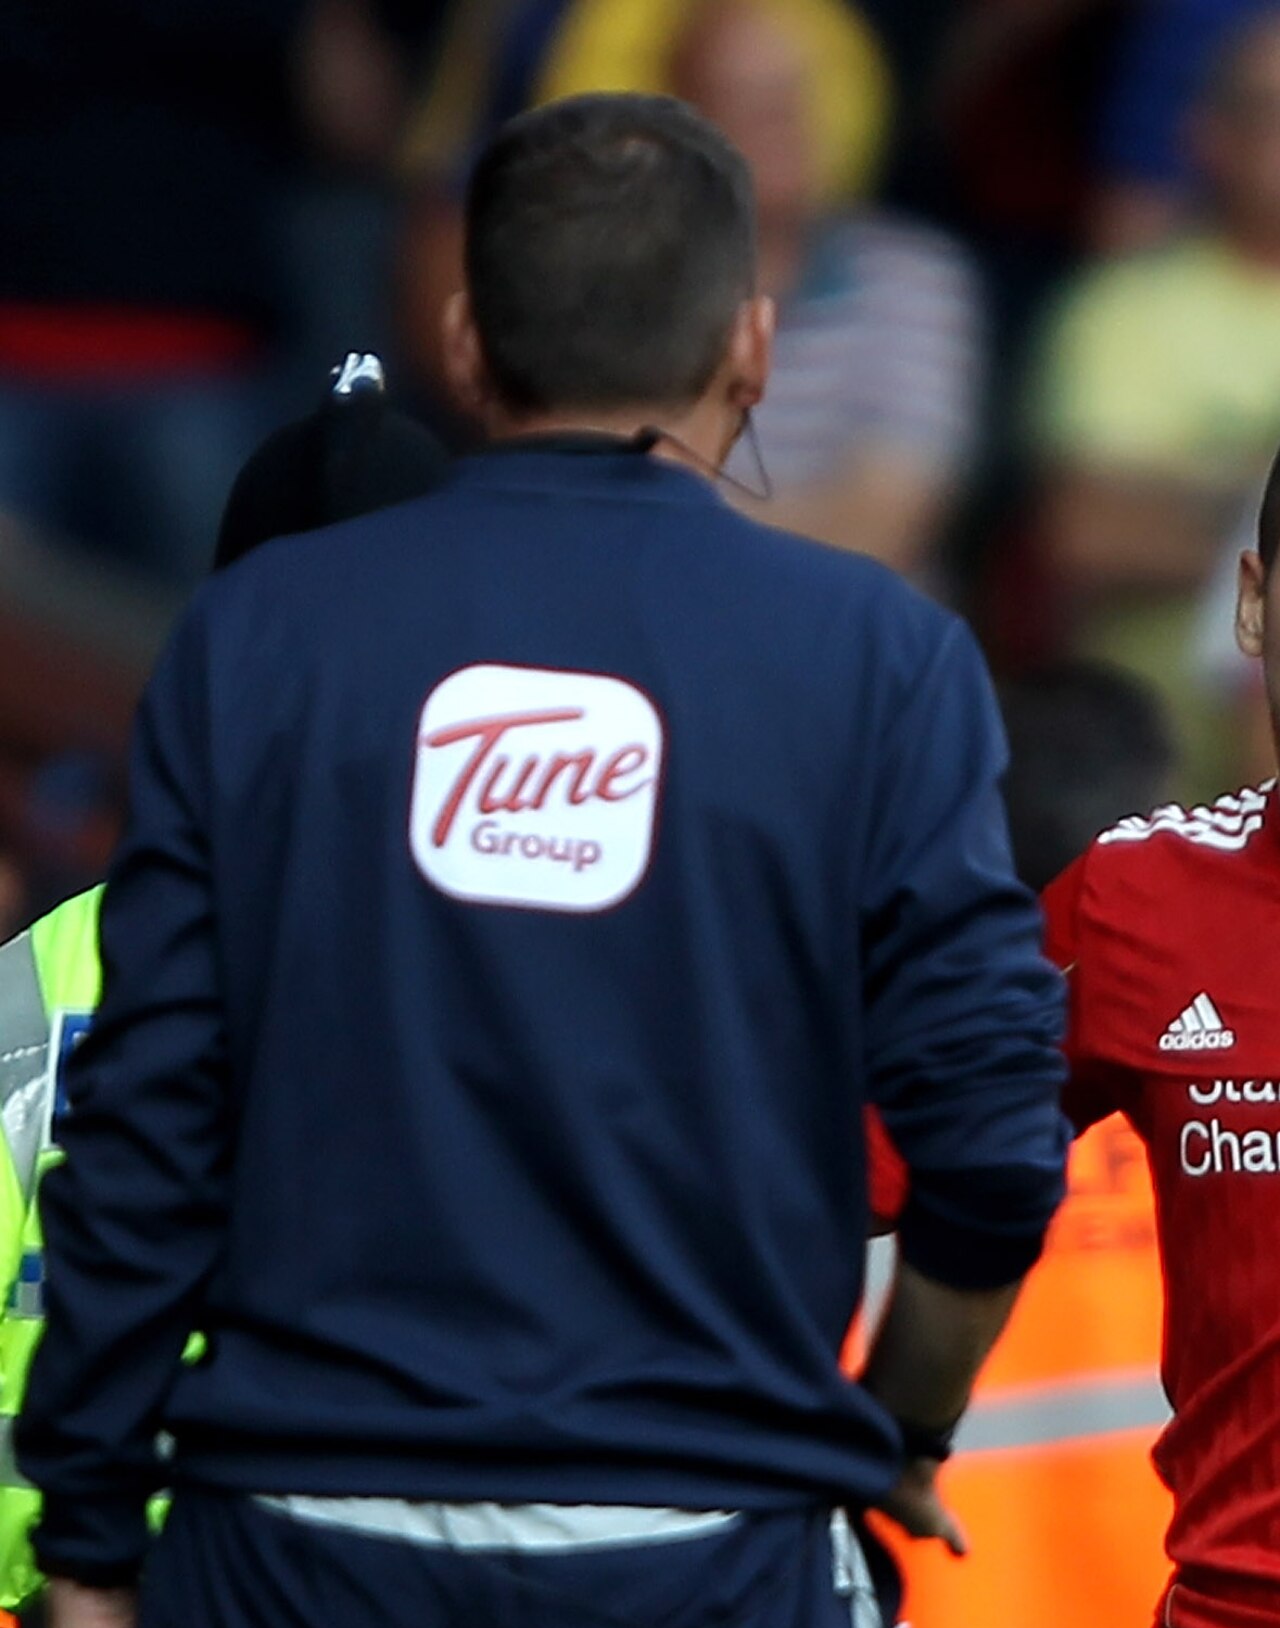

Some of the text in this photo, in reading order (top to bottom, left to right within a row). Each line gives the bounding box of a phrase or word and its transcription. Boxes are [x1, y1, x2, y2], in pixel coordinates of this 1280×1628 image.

[425, 706, 653, 849] Tune
[470, 819, 602, 873] Group
[1158, 1029, 1235, 1052] adidas
